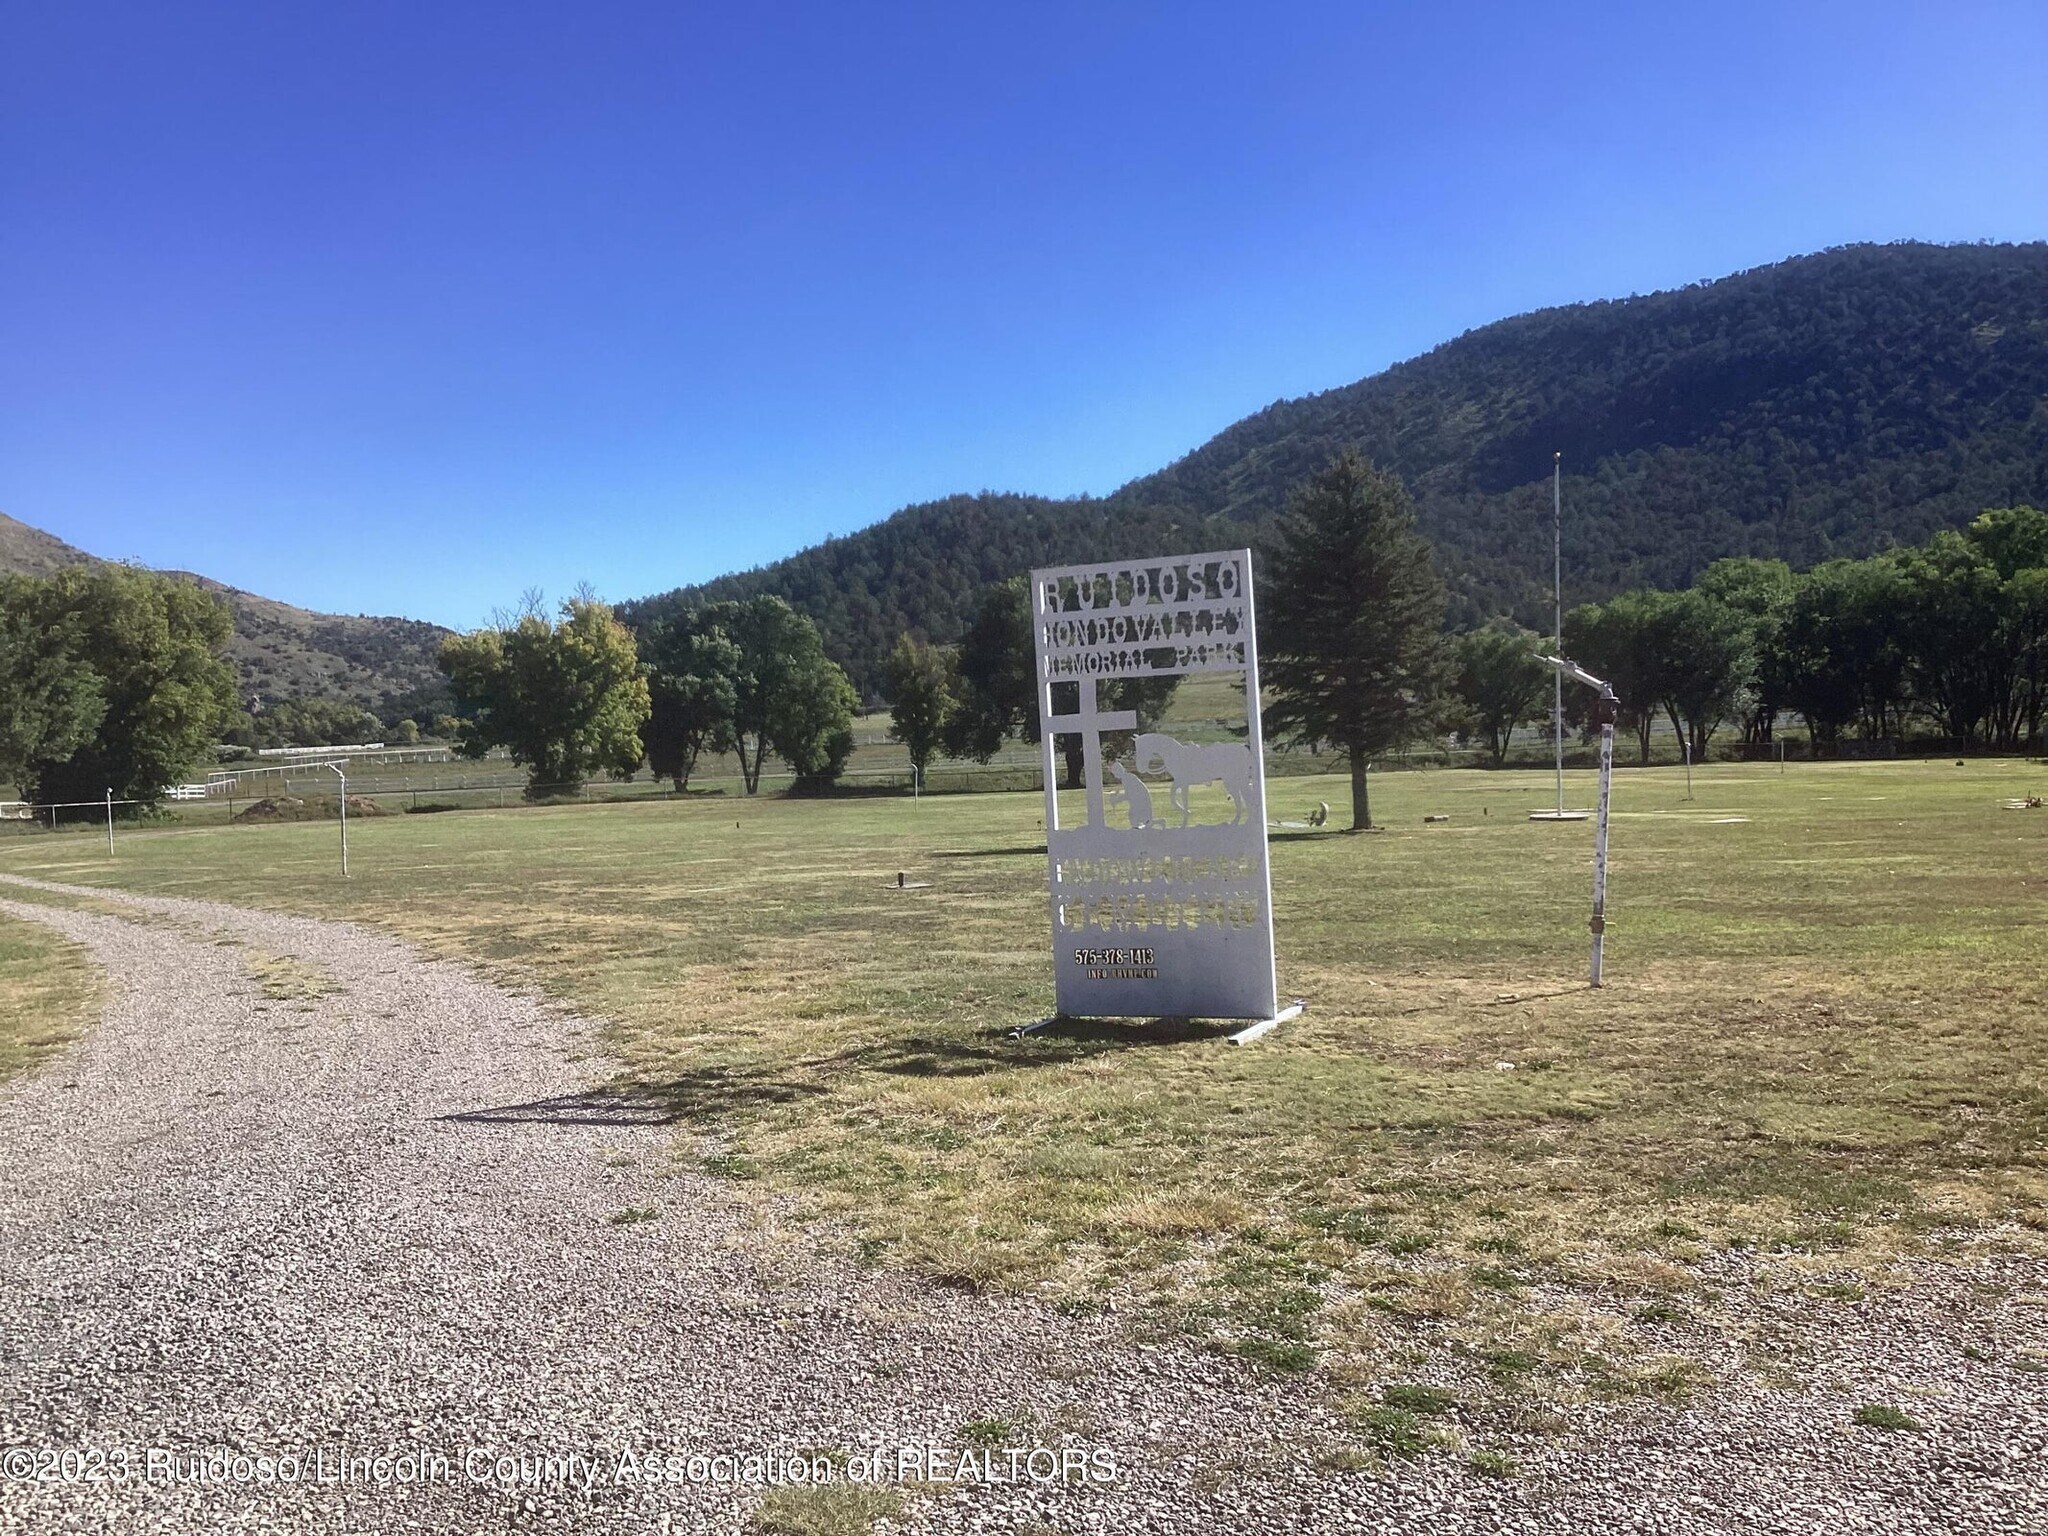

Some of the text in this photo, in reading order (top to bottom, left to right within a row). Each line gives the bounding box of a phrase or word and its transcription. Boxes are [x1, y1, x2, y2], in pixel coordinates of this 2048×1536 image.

[1043, 560, 1238, 614] RUIDOSO
[1045, 641, 1239, 679] MEMORIAL PARK
[1074, 948, 1155, 966] 575-378-1413
